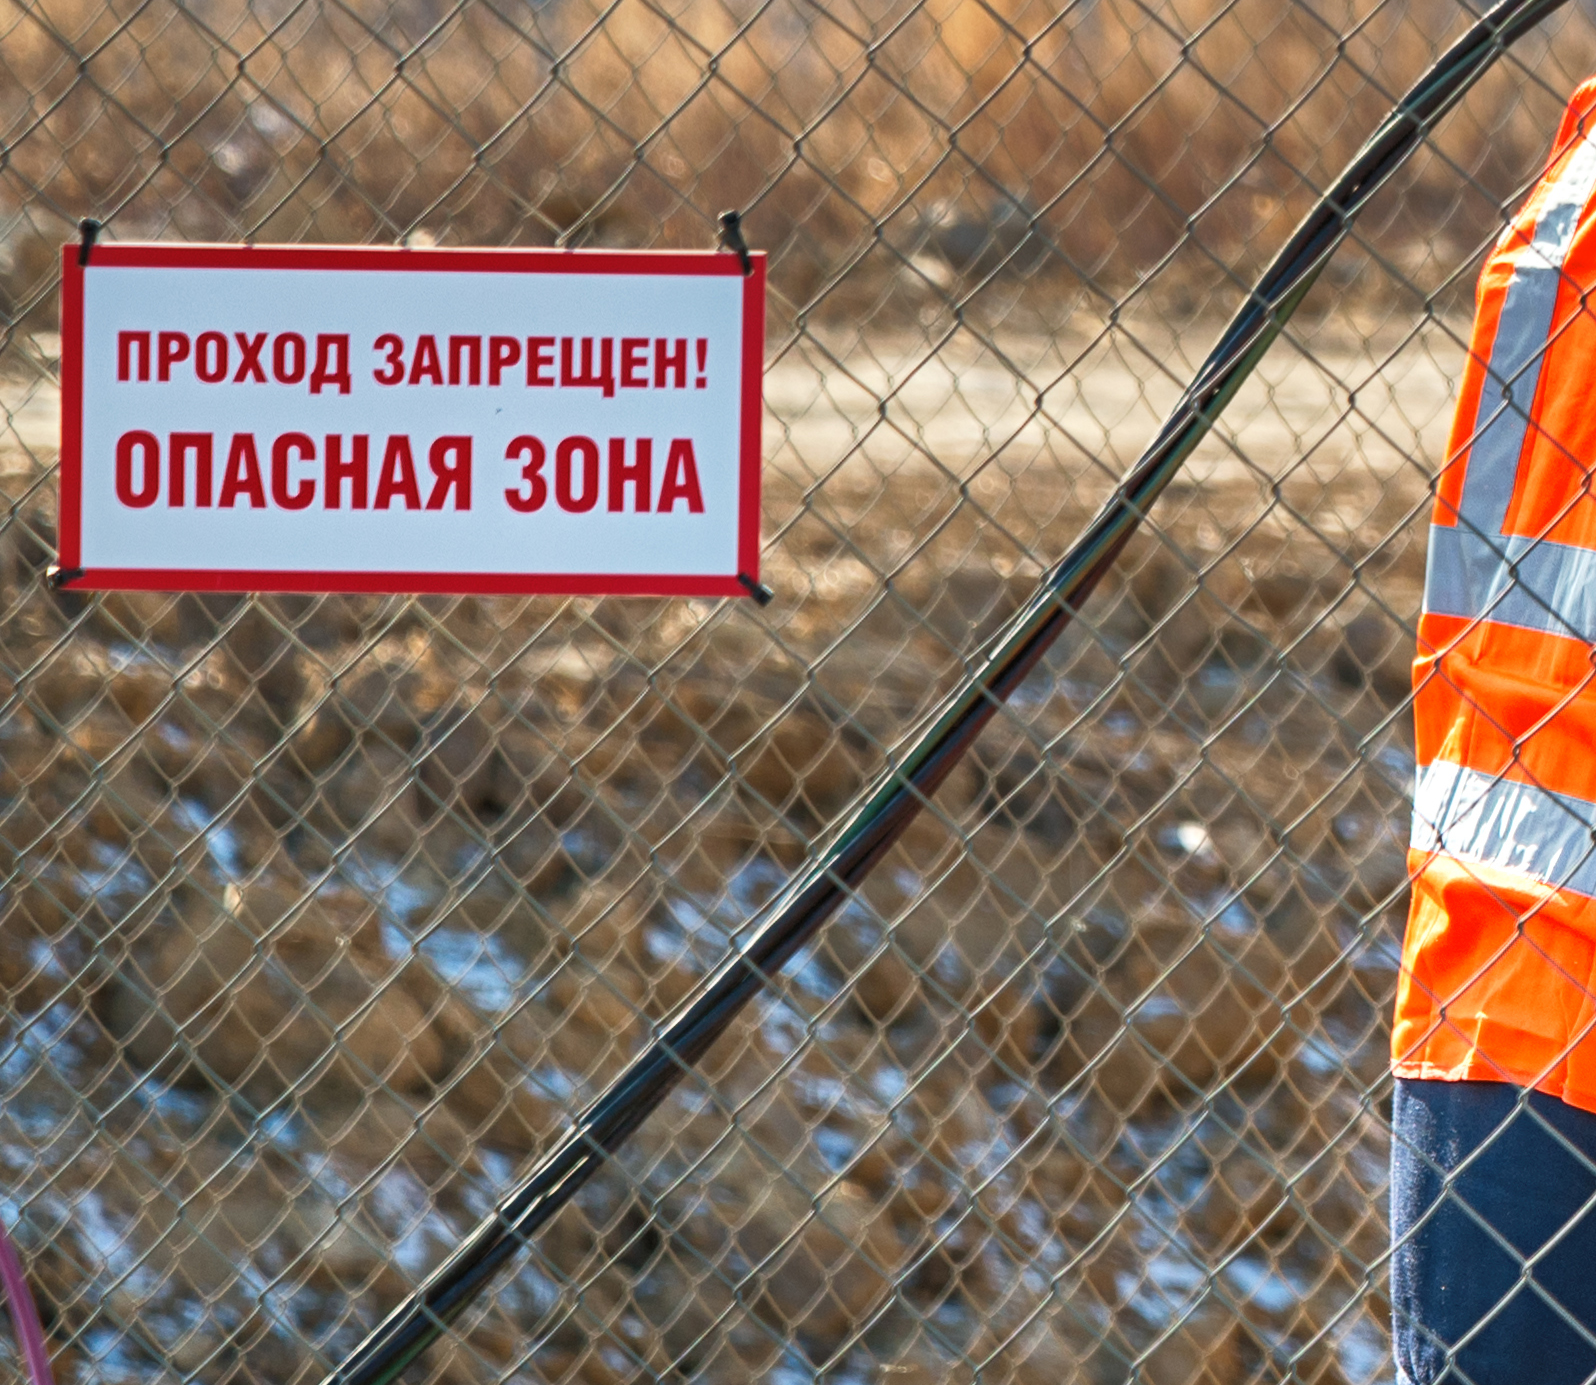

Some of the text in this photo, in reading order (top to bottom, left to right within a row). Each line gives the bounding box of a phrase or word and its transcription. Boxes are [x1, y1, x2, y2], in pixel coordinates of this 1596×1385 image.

[116, 330, 709, 398] ПРОХОД ЗАПРЕЩЕН!
[115, 430, 706, 514] ОПАСНАЯ ЗОНА
